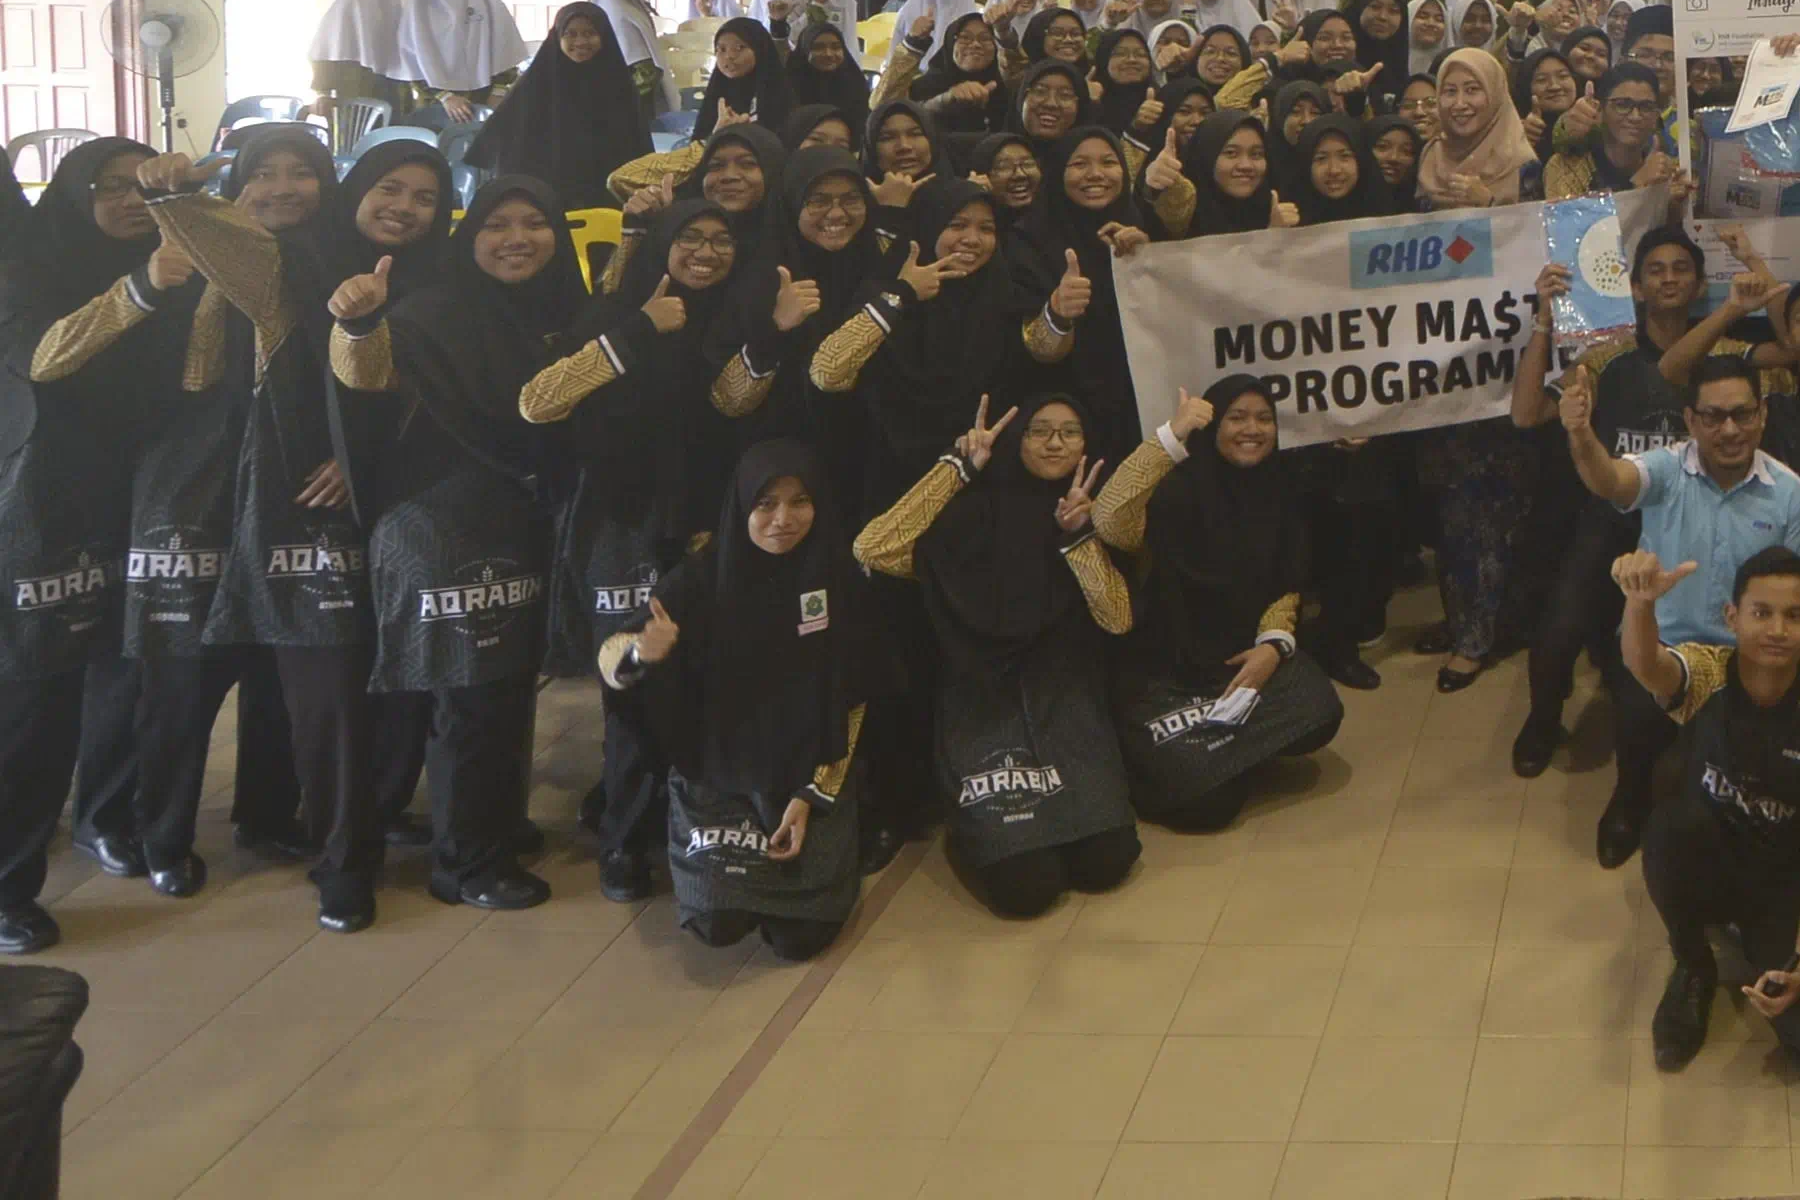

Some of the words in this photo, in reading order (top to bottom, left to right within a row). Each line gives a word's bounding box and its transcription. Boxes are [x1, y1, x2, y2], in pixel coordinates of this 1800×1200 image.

[1366, 235, 1444, 276] RHB
[1214, 304, 1397, 369] MONEY
[1416, 290, 1541, 344] MA$T
[959, 768, 1062, 805] AQRABIN
